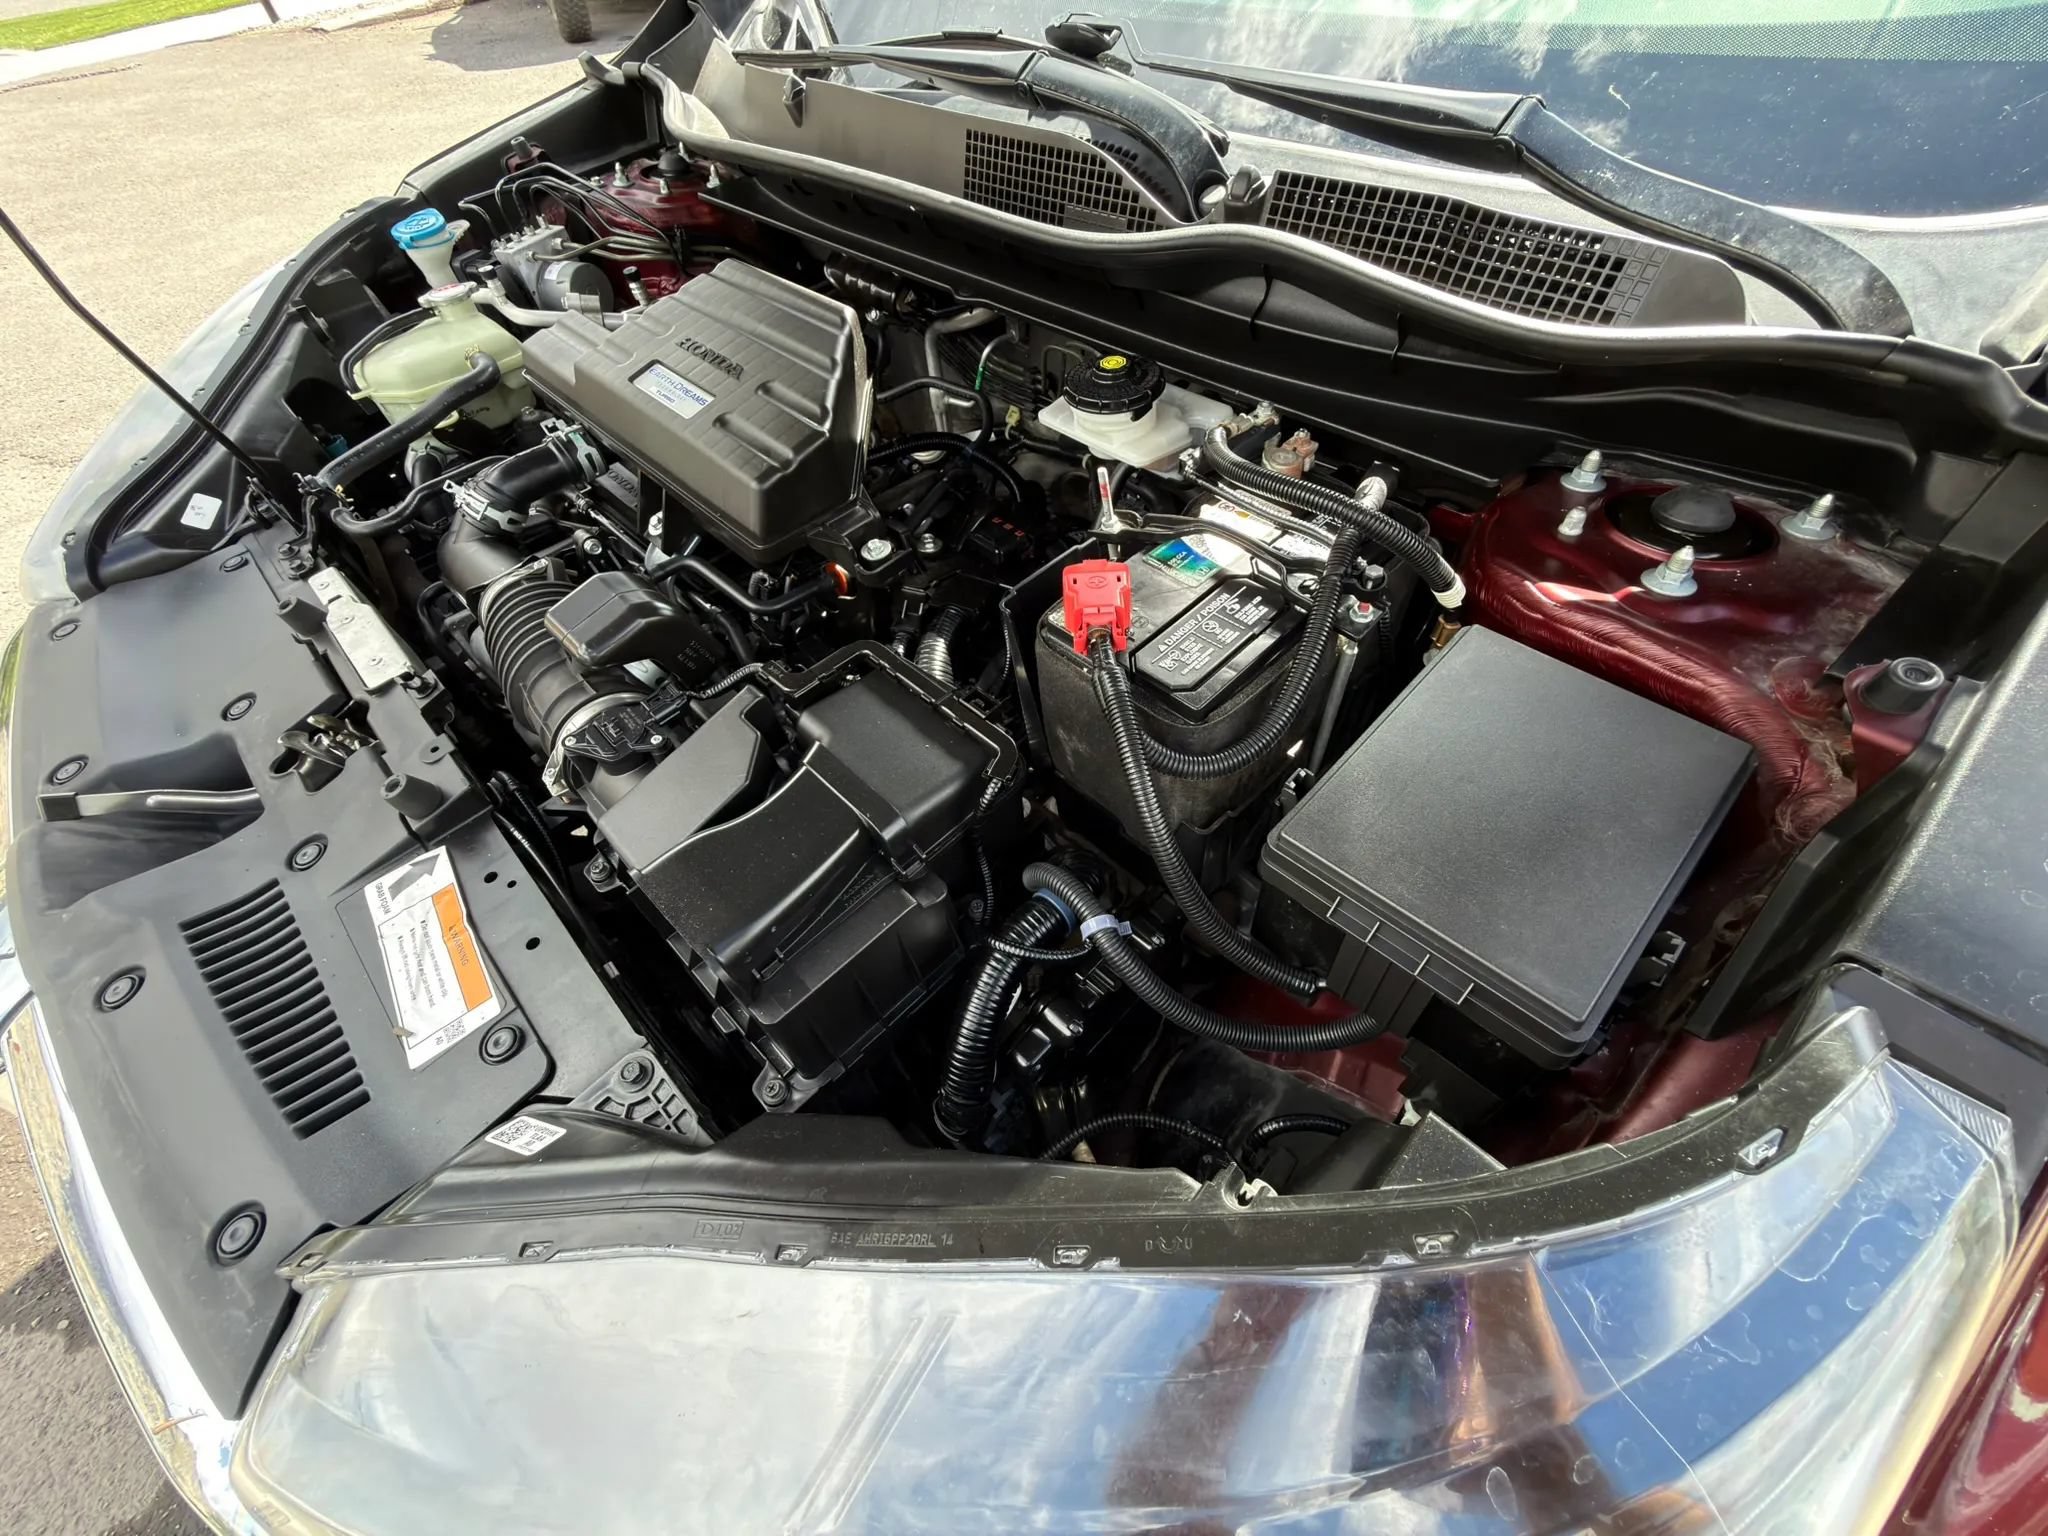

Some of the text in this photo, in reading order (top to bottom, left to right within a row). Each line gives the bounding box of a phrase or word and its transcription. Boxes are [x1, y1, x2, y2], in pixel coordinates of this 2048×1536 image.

[676, 337, 744, 380] HONDA
[1164, 618, 1198, 646] DANGER
[1200, 592, 1231, 617] POISON
[375, 882, 392, 916] GRAB FOAM
[451, 929, 470, 966] WARNING
[941, 1231, 953, 1247] 14
